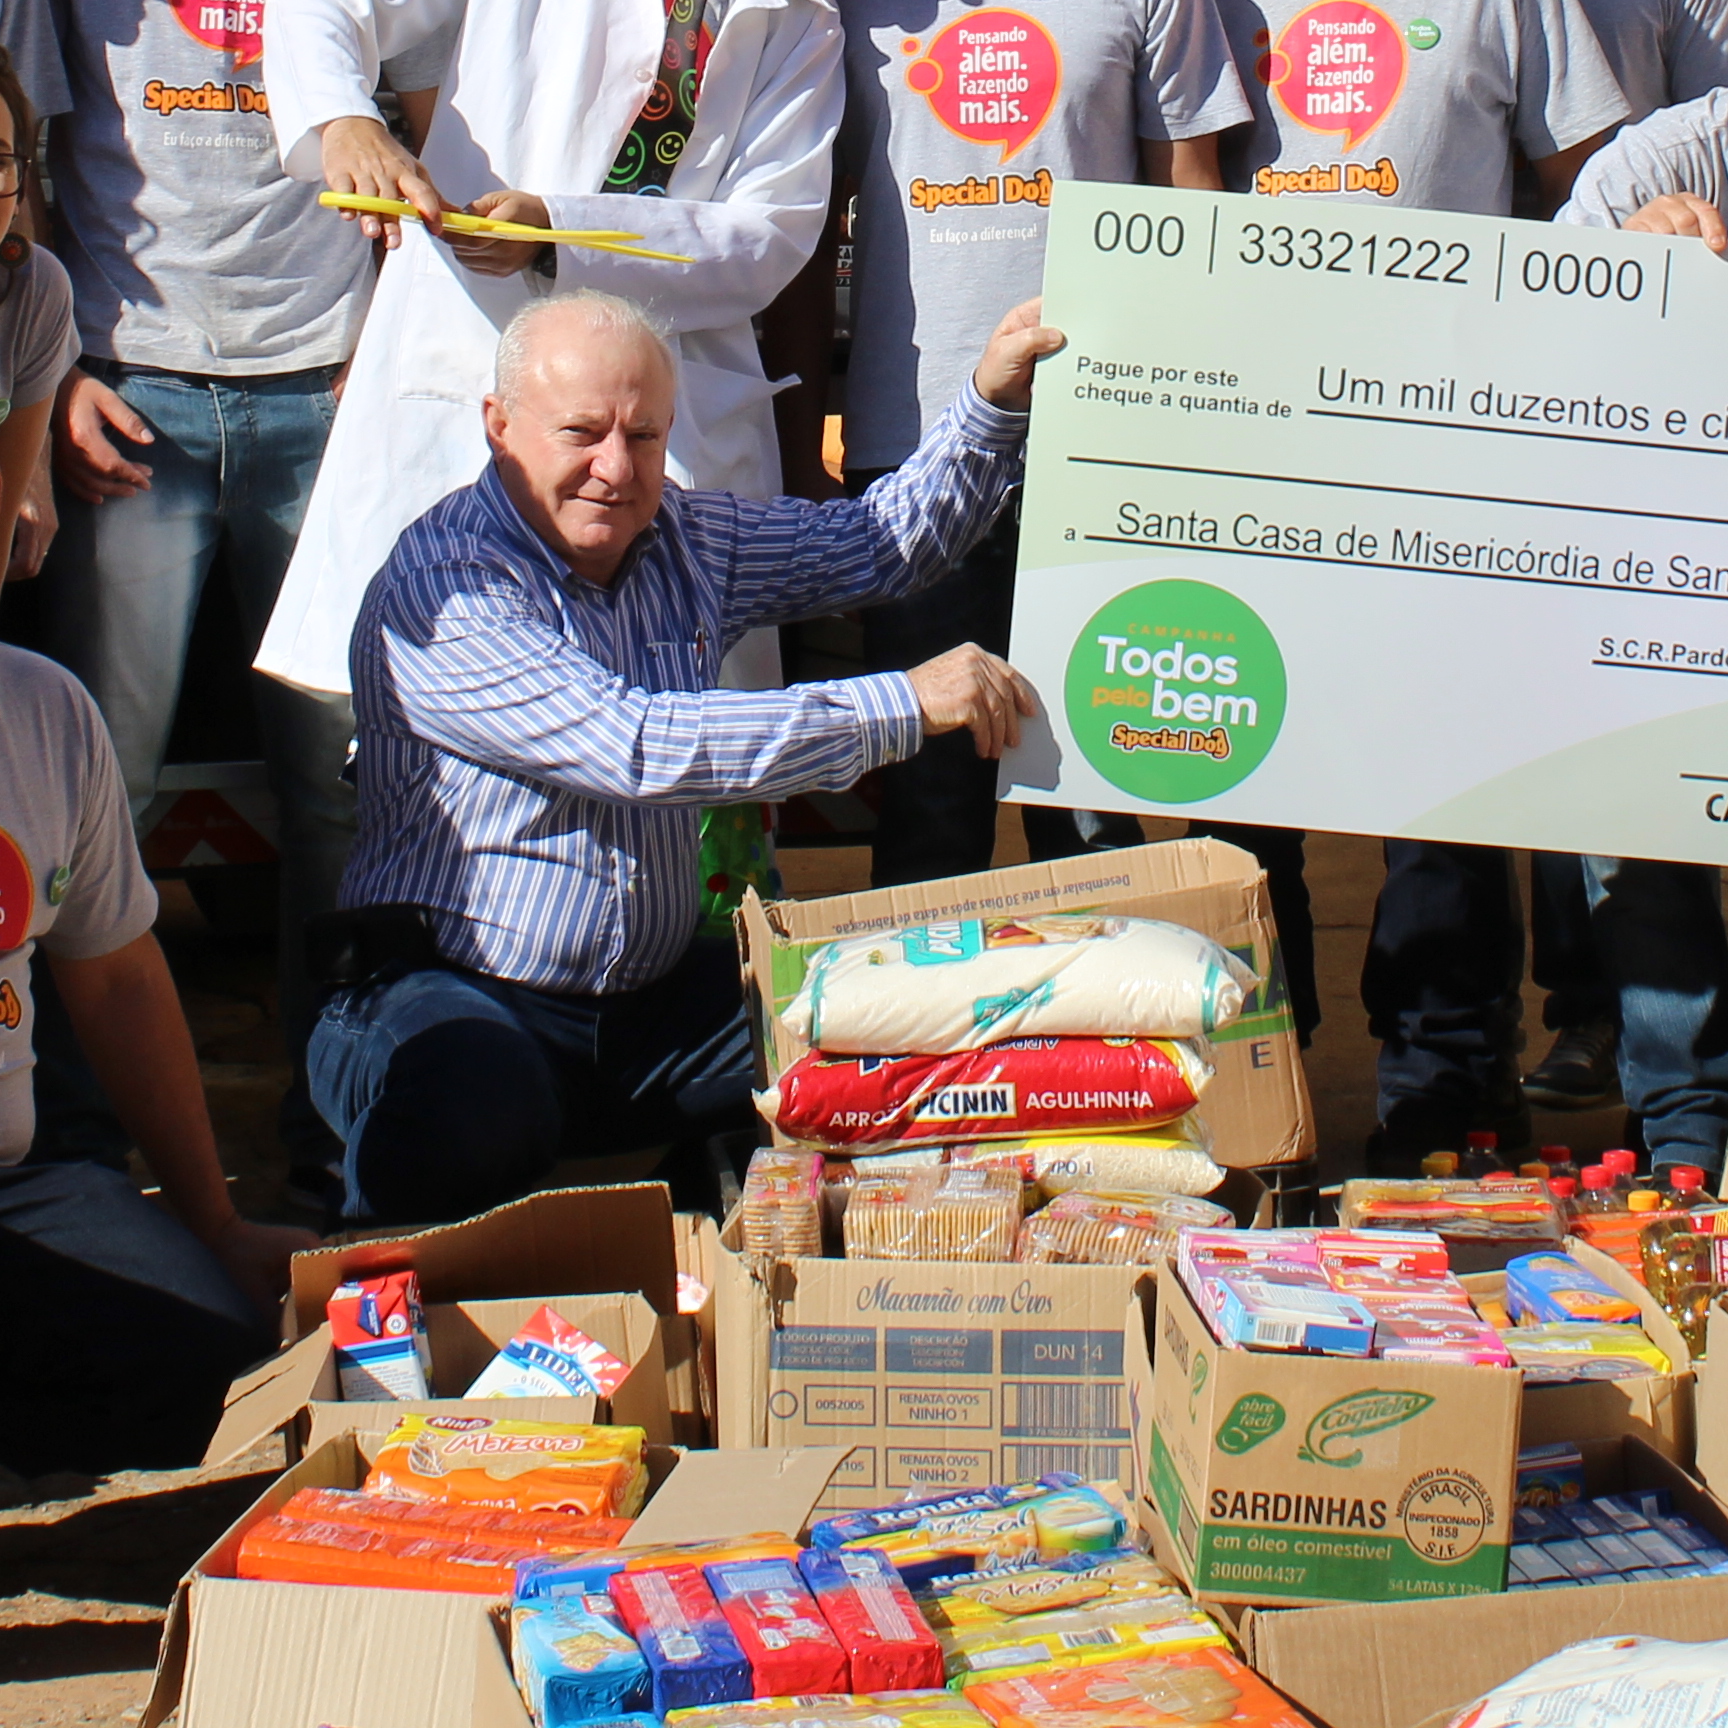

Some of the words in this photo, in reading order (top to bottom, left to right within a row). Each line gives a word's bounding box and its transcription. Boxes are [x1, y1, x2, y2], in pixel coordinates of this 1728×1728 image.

[958, 25, 1028, 46] Pensando
[958, 45, 1028, 75] além.
[958, 73, 1029, 95] Fazendo
[958, 94, 1029, 125] mais.
[909, 175, 998, 213] Special
[1004, 168, 1054, 208] Dog
[929, 227, 943, 243] Eu
[945, 226, 969, 246] faço
[1093, 210, 1186, 258] 000
[1238, 222, 1471, 285] 33321222
[1521, 249, 1644, 302] 0000
[1076, 355, 1144, 384] Pague
[1151, 363, 1187, 386] por
[1193, 367, 1239, 388] este
[1074, 381, 1154, 410] cheque
[1160, 392, 1174, 408] a
[1179, 390, 1260, 420] quantia
[1266, 399, 1292, 419] de
[1316, 364, 1385, 404] Um
[1400, 374, 1455, 413] mil
[1469, 382, 1651, 432] duzentos
[1663, 404, 1687, 434] e
[1063, 525, 1077, 542] a
[1116, 500, 1219, 545] Santa
[1232, 511, 1324, 554] Casa
[1335, 521, 1379, 558] de
[1391, 527, 1601, 581] Misericórdia
[1612, 547, 1655, 584] de
[1127, 622, 1237, 644] CAMPANHA
[1097, 634, 1239, 686] Todos
[1090, 684, 1150, 709] pelo
[1151, 678, 1258, 727] bem
[1111, 722, 1186, 752] Special
[1188, 726, 1231, 760] Dog
[980, 896, 1004, 910] Dias
[1005, 893, 1020, 907] 30
[1025, 1090, 1154, 1110] AGULHINHA
[856, 1276, 962, 1313] Macarrão
[967, 1290, 1009, 1313] com
[1010, 1278, 1053, 1314] Ovos
[1033, 1343, 1075, 1361] DUN
[1079, 1344, 1103, 1361] 14
[898, 1393, 944, 1405] RENATA
[946, 1394, 980, 1406] OVOS
[909, 1408, 957, 1421] NINHO
[962, 1409, 969, 1421] 1
[441, 1432, 584, 1455] Maizena
[1420, 1482, 1472, 1507] BRASIL
[871, 1490, 991, 1527] Renata
[1209, 1488, 1388, 1530] SARDINHAS
[1408, 1513, 1481, 1527] INSPECIONADO
[1430, 1526, 1459, 1539] 1858
[1212, 1535, 1241, 1549] em
[1247, 1533, 1288, 1553] óleo
[1294, 1538, 1392, 1560] comestível
[1210, 1561, 1307, 1584] 300004437
